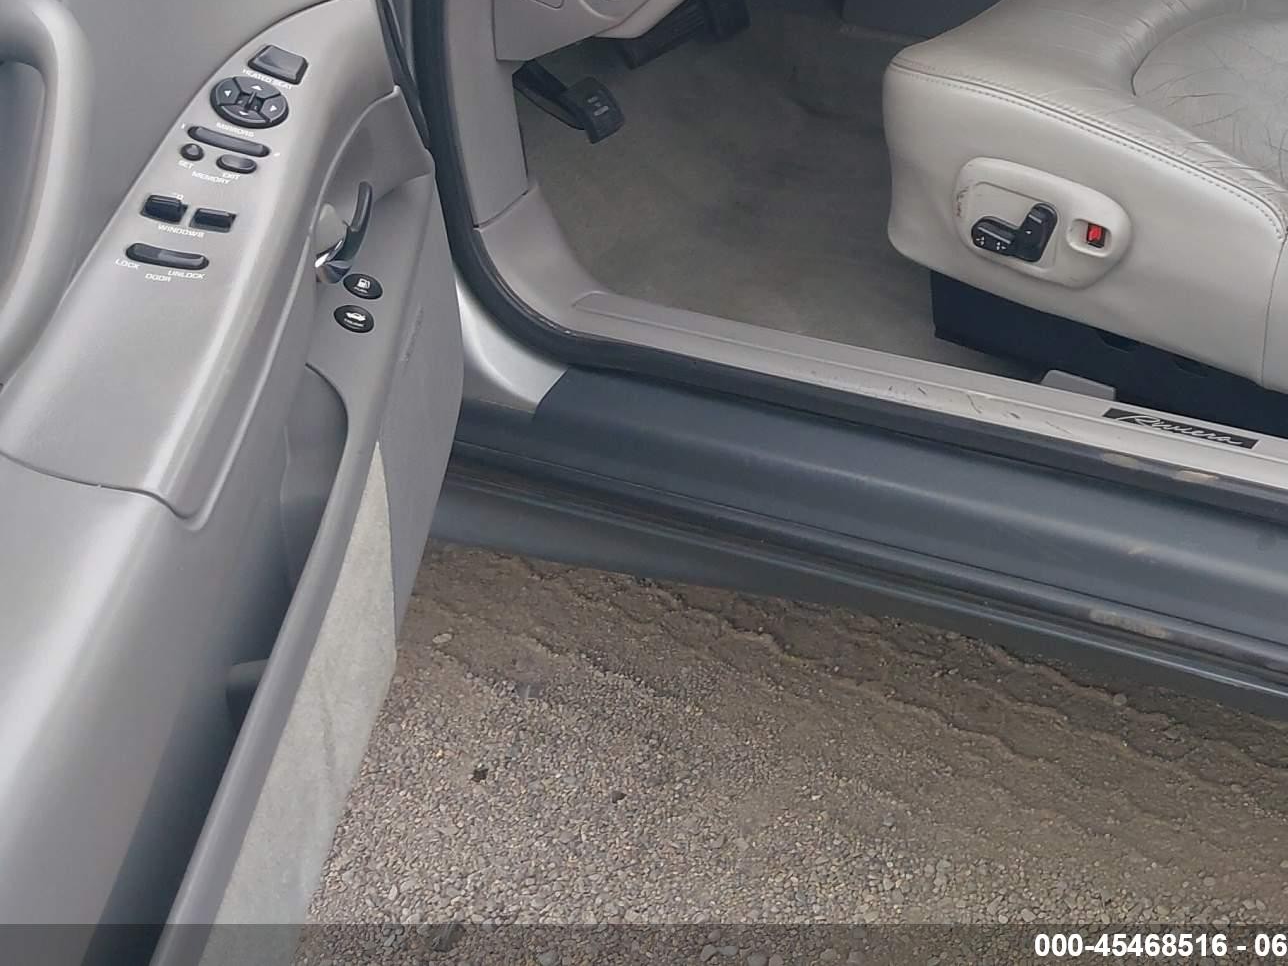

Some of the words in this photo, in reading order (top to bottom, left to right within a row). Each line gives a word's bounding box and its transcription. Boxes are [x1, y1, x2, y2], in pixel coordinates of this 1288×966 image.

[191, 170, 231, 185] MEMORY
[157, 224, 204, 239] WINDOWS
[115, 258, 141, 270] LOCK
[144, 273, 172, 283] DOOR
[167, 269, 206, 280] UNLOCK
[1116, 414, 1243, 445] Riviera
